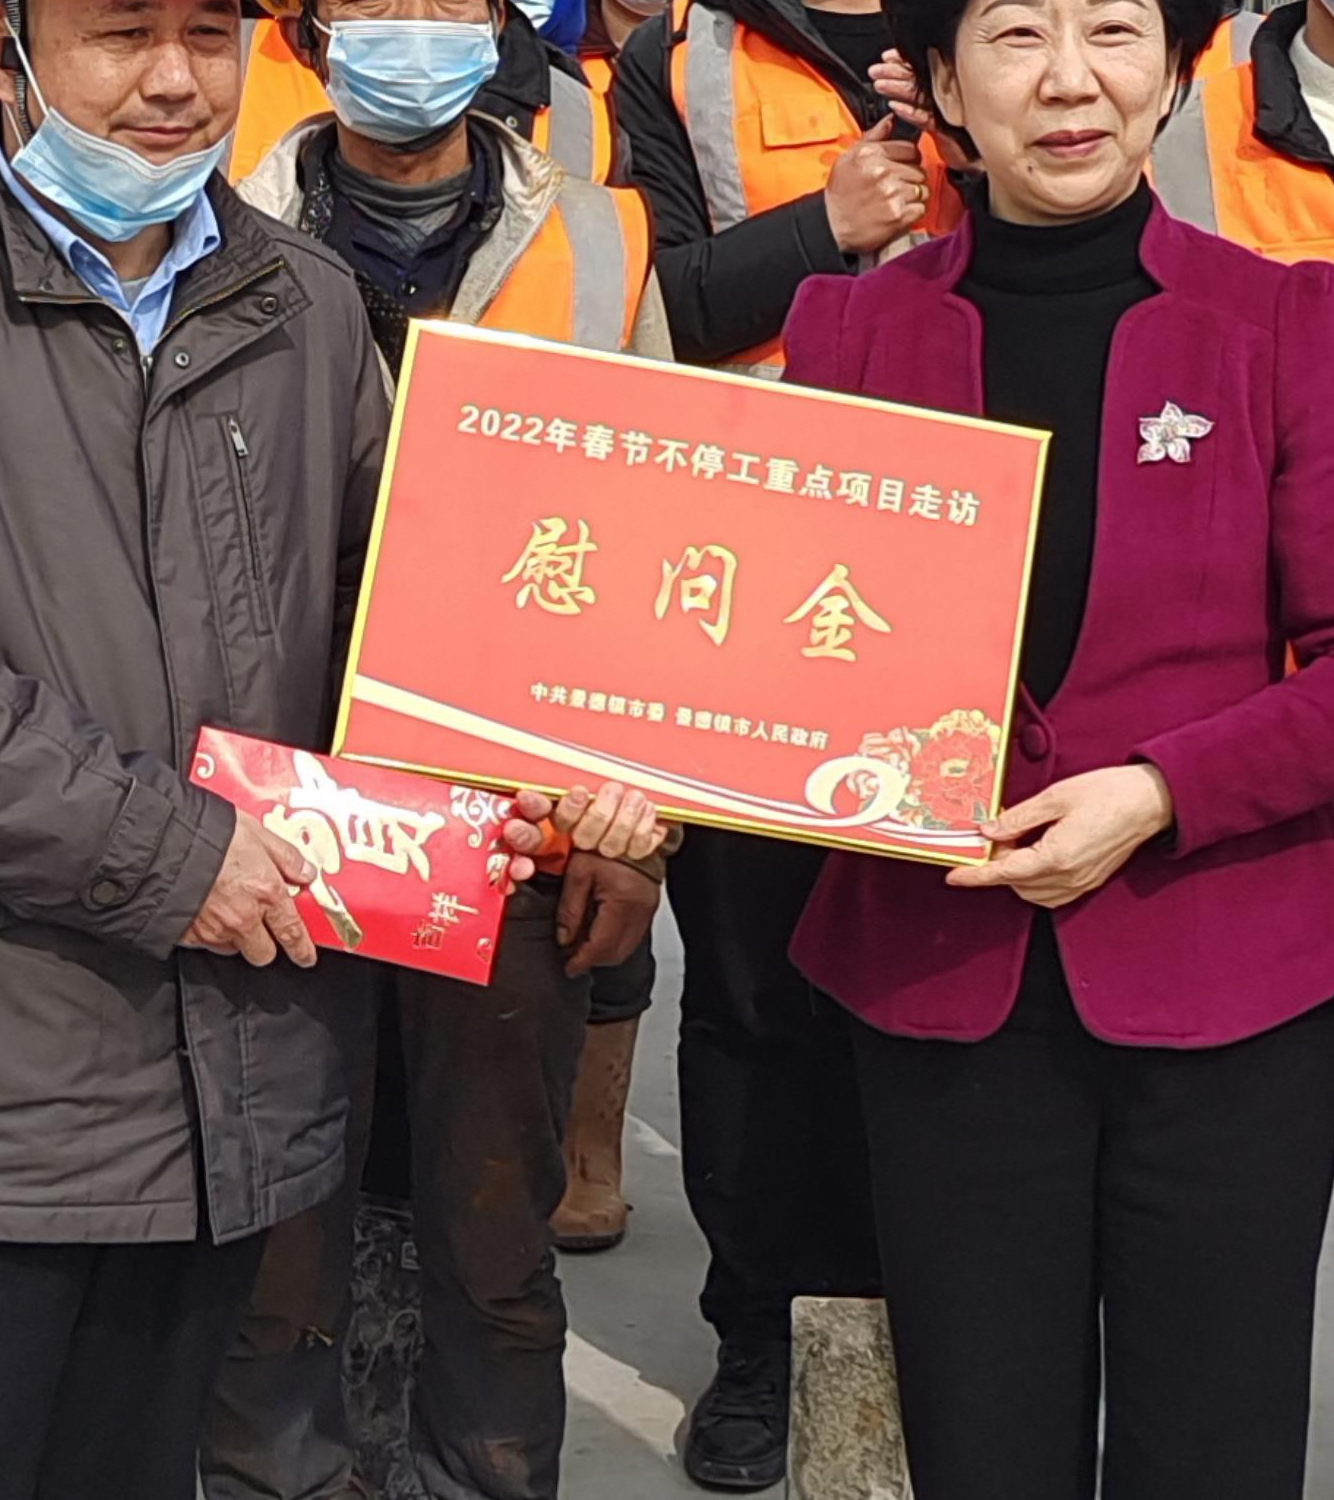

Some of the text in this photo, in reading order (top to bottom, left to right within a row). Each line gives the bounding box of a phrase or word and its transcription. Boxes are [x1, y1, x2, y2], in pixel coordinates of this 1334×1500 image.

[457, 403, 981, 527] 2022年春节不停工重点项目走访
[502, 517, 892, 663] 慰问金
